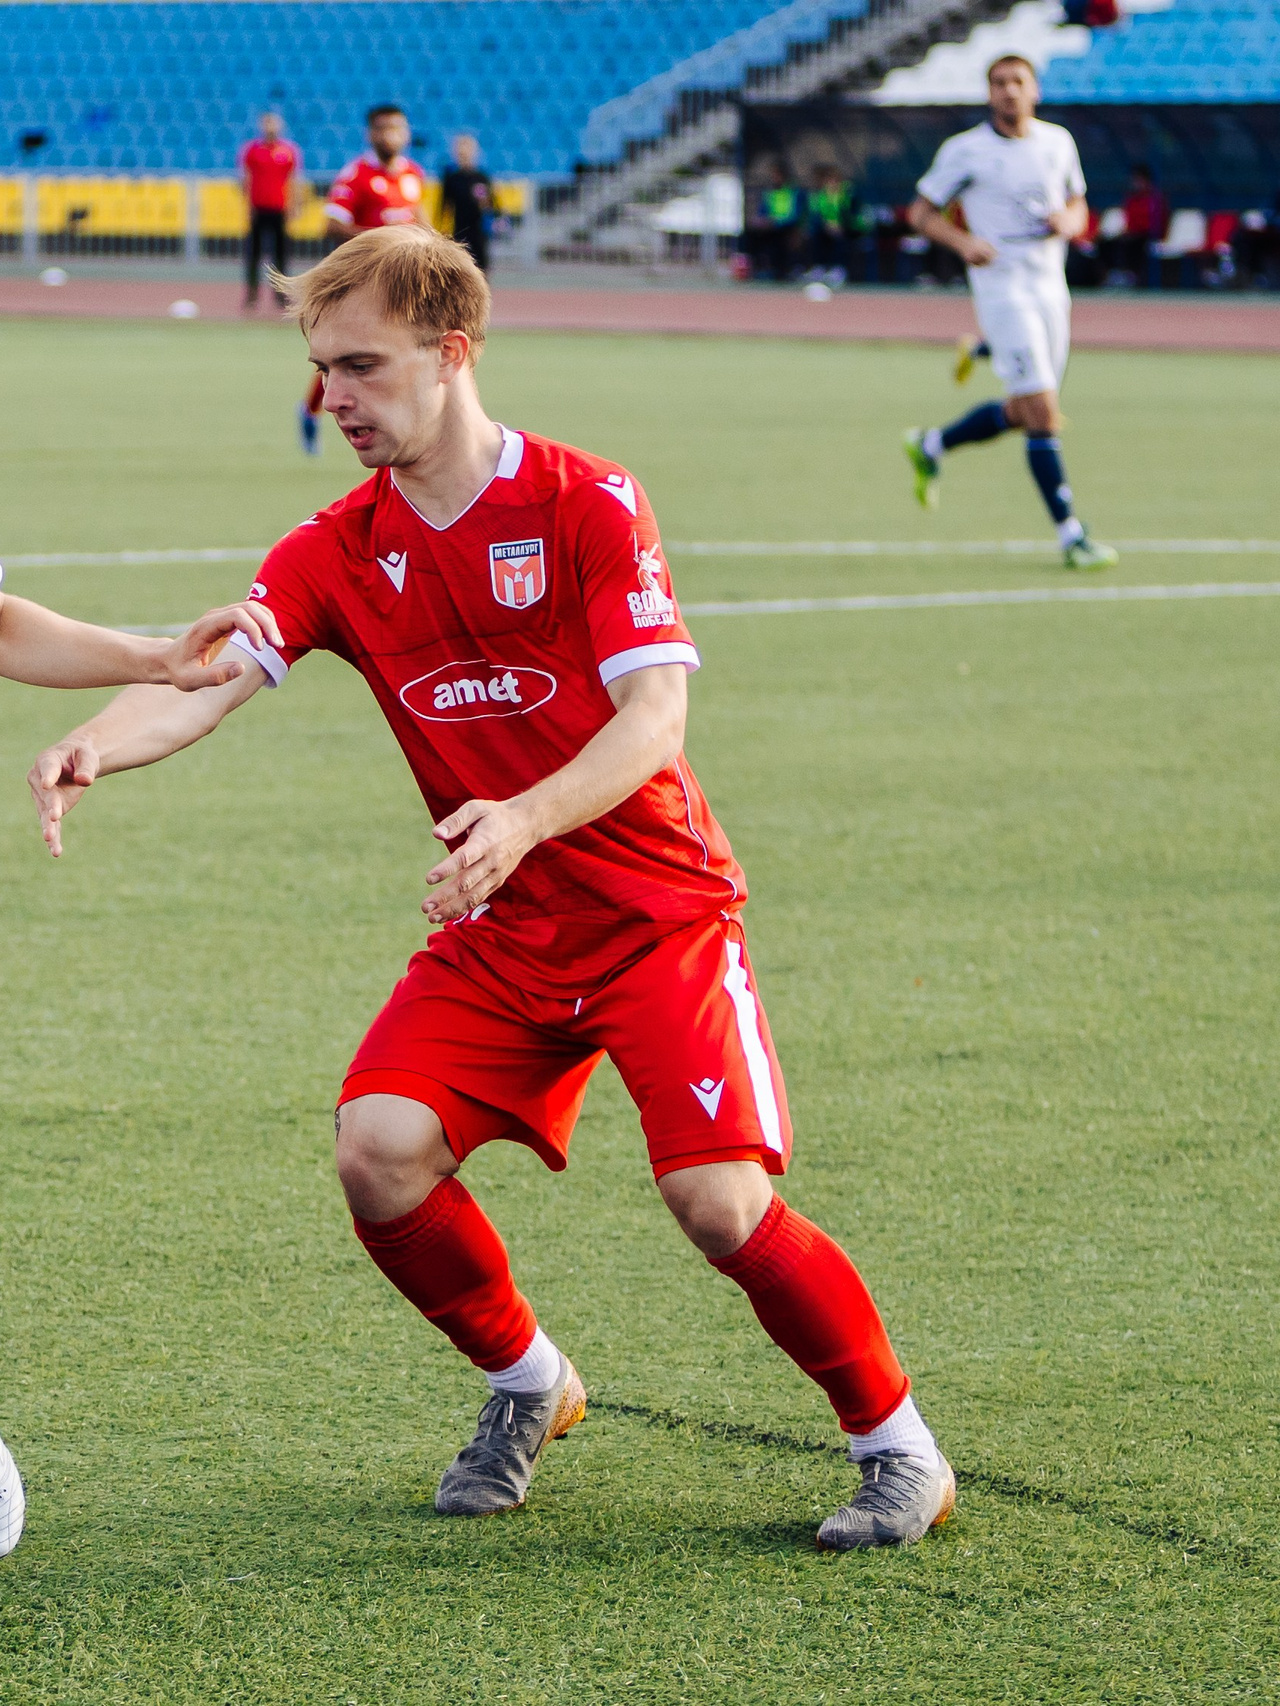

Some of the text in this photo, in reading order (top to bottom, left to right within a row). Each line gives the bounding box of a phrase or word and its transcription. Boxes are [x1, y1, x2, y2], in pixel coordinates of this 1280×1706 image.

[494, 543, 539, 559] МЕТАЛЛУРГ
[626, 589, 656, 614] 80
[433, 671, 522, 710] amet
